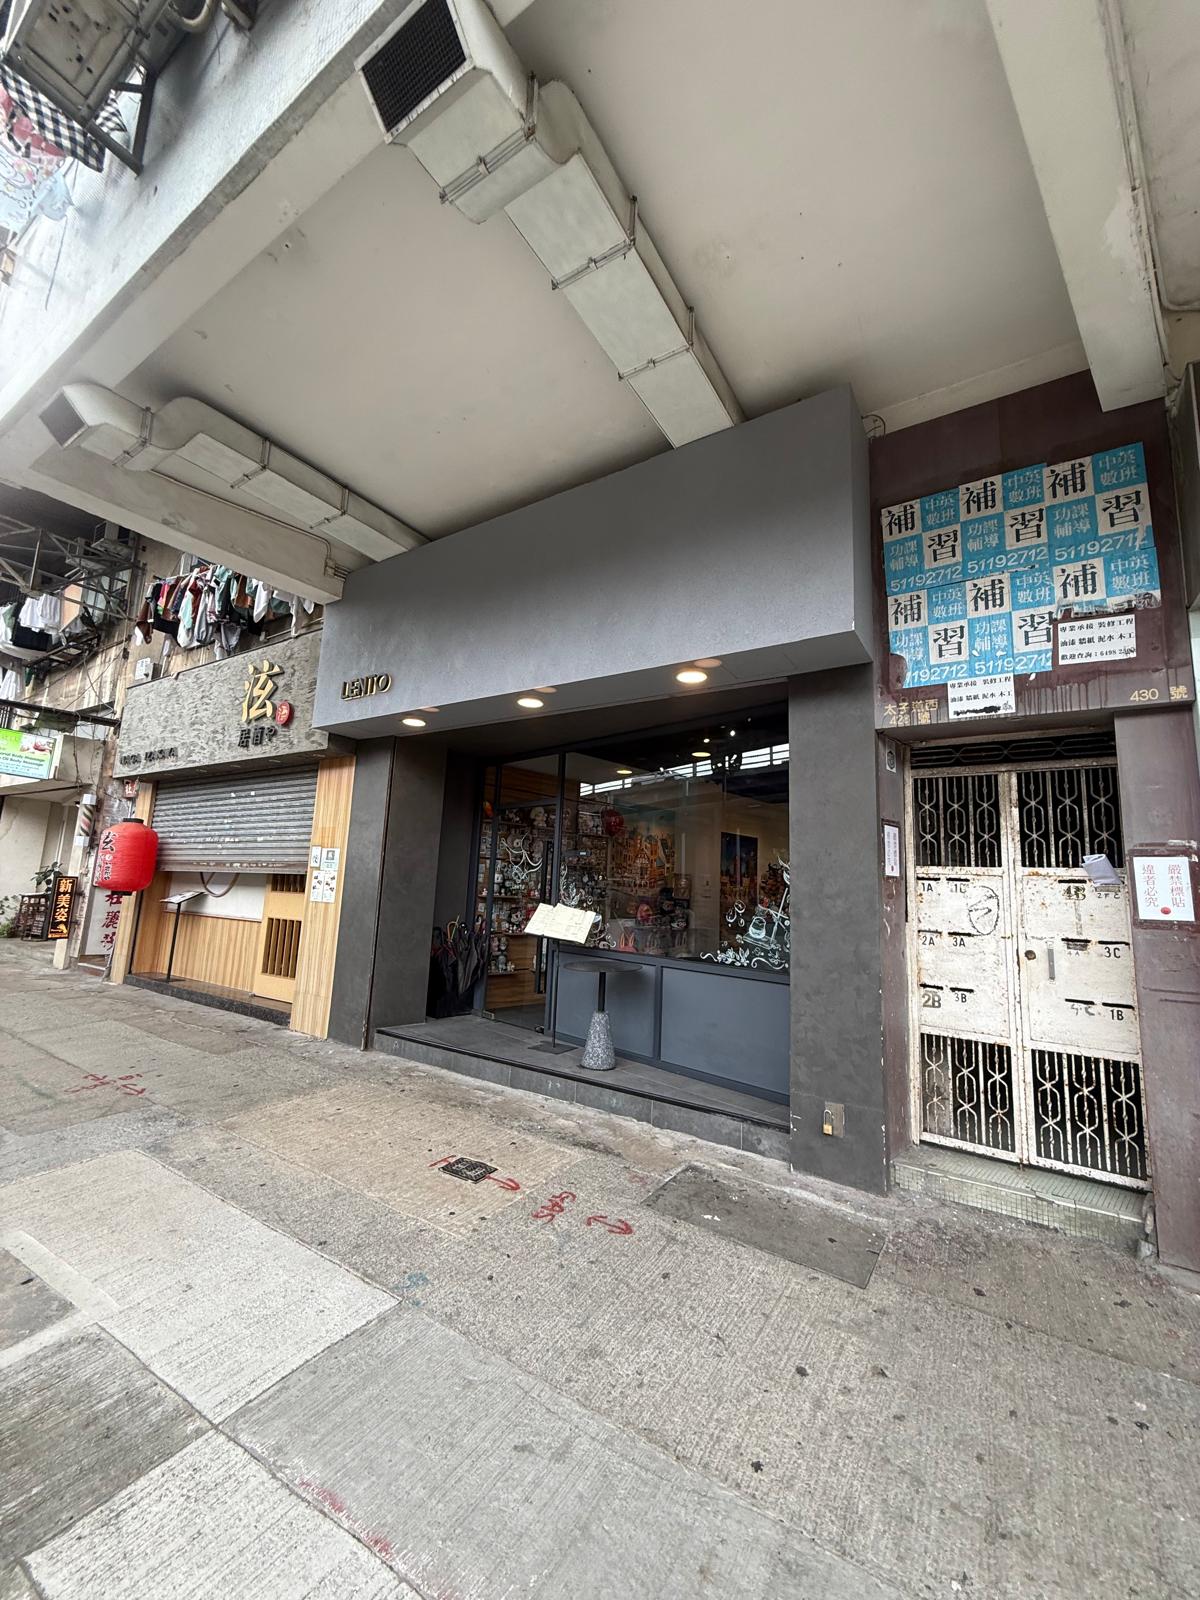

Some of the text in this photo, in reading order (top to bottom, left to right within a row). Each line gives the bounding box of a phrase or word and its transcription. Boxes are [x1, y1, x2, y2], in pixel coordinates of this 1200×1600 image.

[1098, 450, 1137, 469] 中英
[1007, 469, 1040, 490] 中英
[1046, 462, 1086, 498] 補
[925, 494, 953, 510] 中英
[962, 481, 996, 515] 補
[1102, 490, 1141, 528] 習
[886, 504, 916, 537] 補
[1009, 508, 1044, 543] 習
[928, 529, 959, 563] 習
[967, 546, 1049, 574] 51192712
[1111, 553, 1150, 574] 中英
[890, 566, 963, 592] 51192712
[1016, 571, 1050, 587] 中英
[1057, 563, 1098, 599] 補
[932, 587, 962, 602] 中英
[969, 578, 1006, 612] 補
[891, 594, 923, 626] 補
[933, 625, 965, 658] 習
[1018, 610, 1057, 647] 習
[341, 674, 391, 701] LENTO
[1130, 685, 1188, 702] 430 號
[884, 698, 939, 716] 太子道西
[921, 882, 933, 892] 1A
[1141, 864, 1160, 907] 違者必究
[54, 879, 73, 922] 新美姿
[921, 936, 935, 946] 2A
[952, 937, 966, 947] 3A
[1104, 946, 1121, 959] 3C
[921, 991, 941, 1008] 2B
[954, 993, 967, 1003] 3B
[1110, 1009, 1124, 1021] 1B
[531, 1191, 577, 1226] GAS
